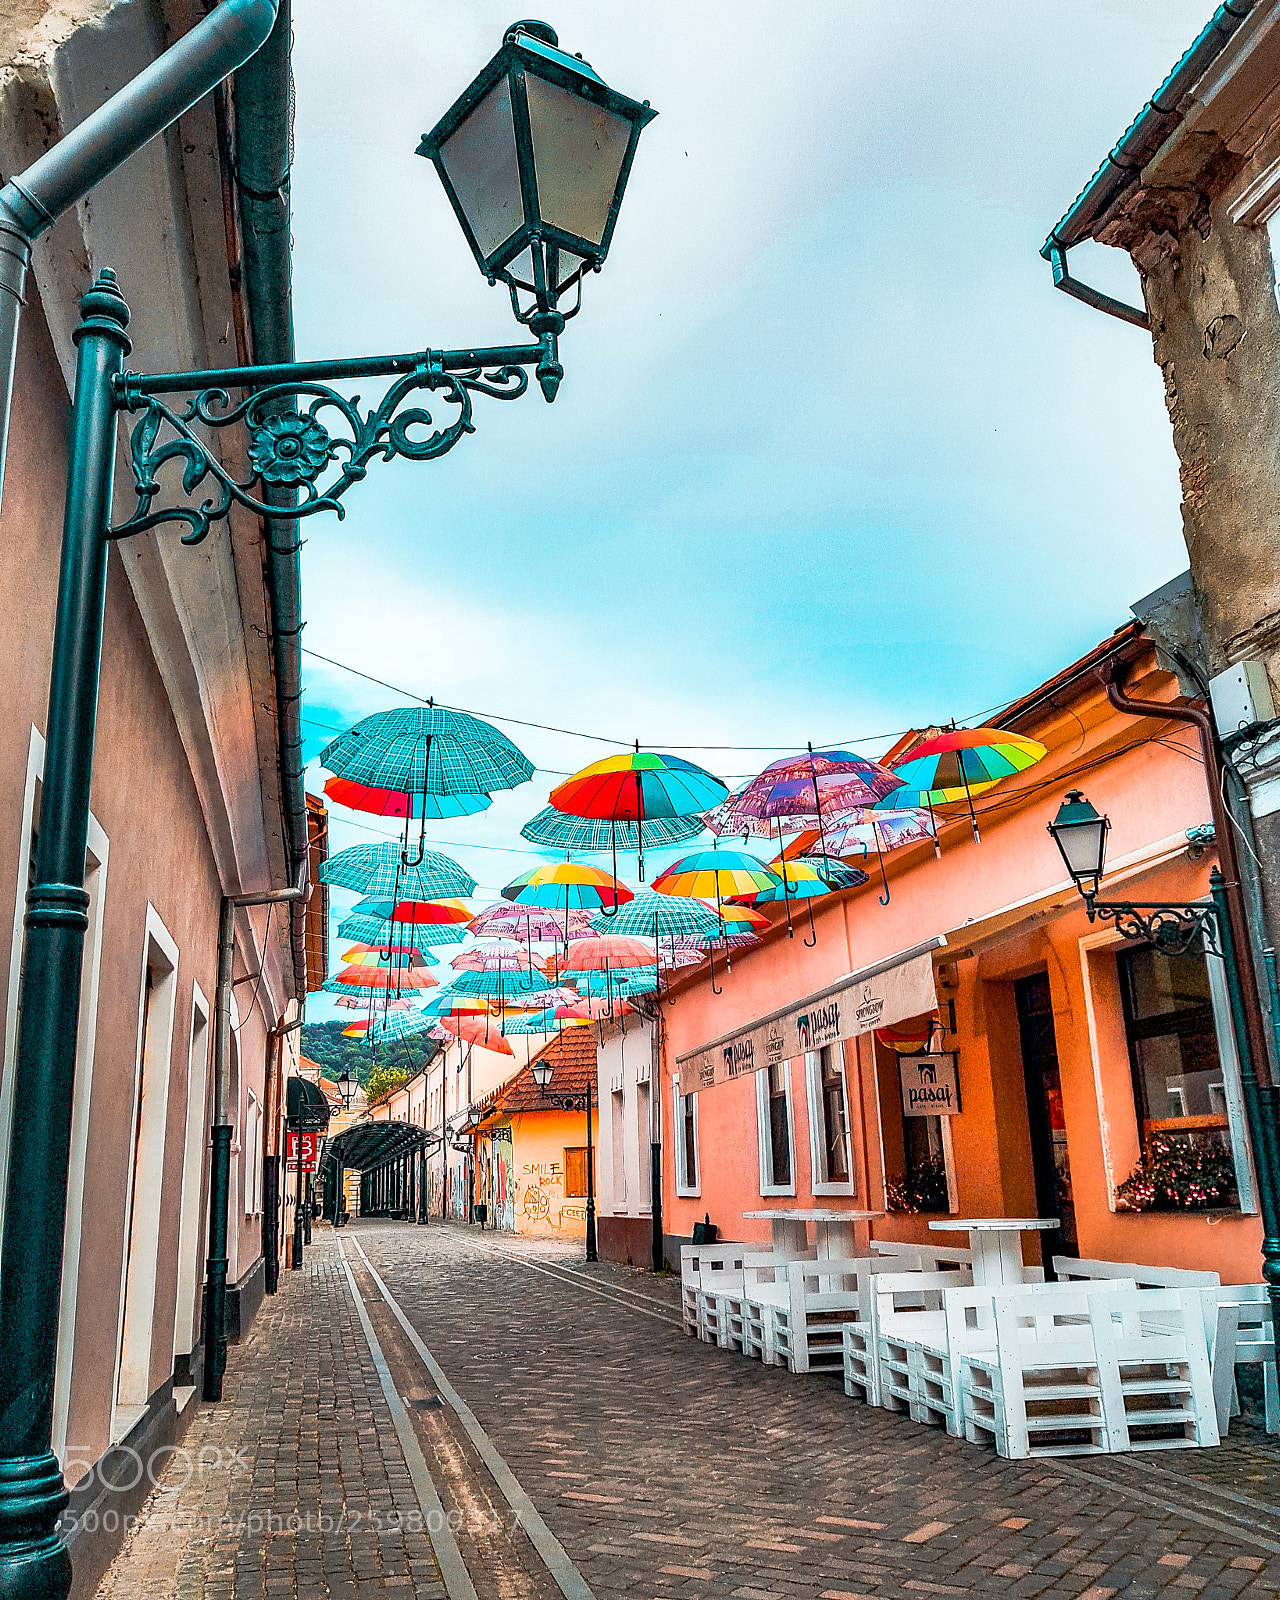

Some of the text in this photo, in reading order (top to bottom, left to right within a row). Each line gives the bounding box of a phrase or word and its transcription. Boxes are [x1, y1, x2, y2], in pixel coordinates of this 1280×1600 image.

[909, 1084, 952, 1109] pasaj
[522, 1163, 563, 1175] SMILE
[539, 1175, 563, 1187] ROCK
